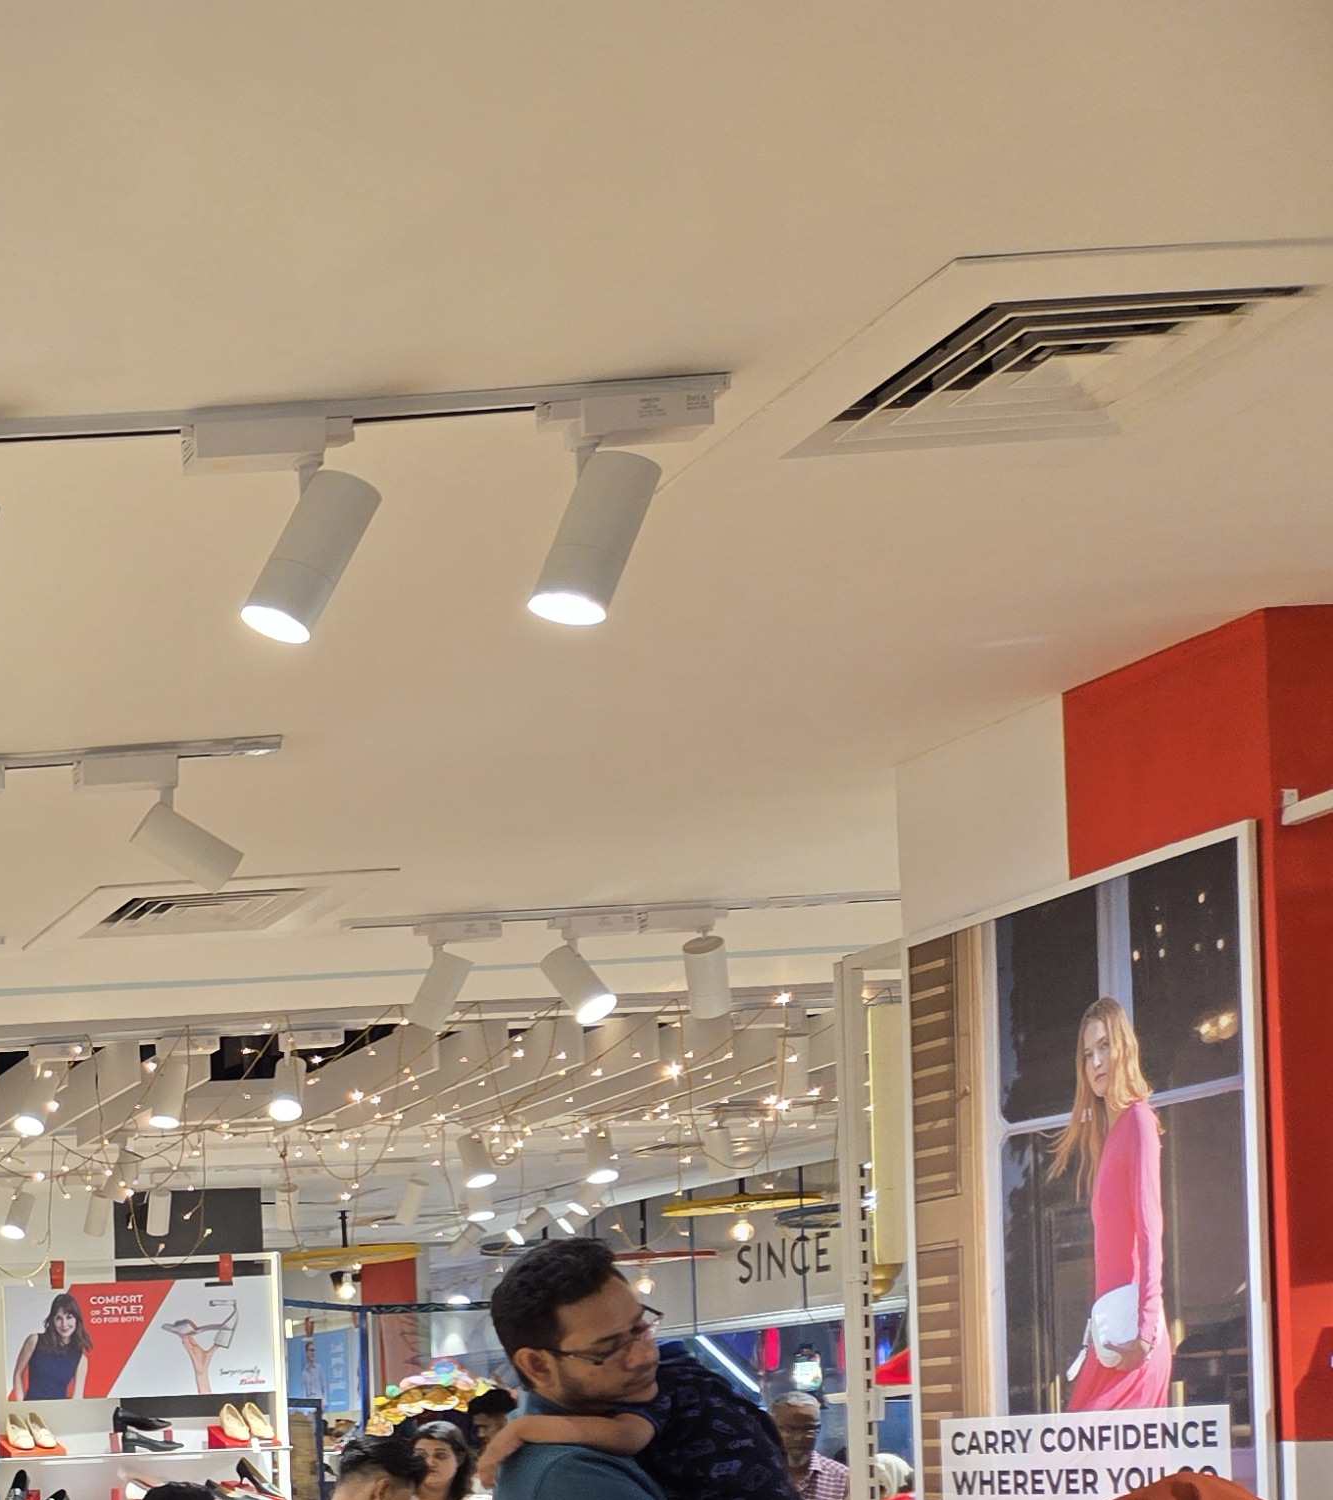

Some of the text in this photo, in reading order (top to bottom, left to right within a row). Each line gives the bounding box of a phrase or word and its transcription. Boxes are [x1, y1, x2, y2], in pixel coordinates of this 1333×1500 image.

[737, 1231, 831, 1284] SINCE
[90, 1294, 143, 1305] COMFORT
[103, 1305, 143, 1315] STYLE?
[951, 1420, 1218, 1455] CARRY CONFIDENCE
[952, 1468, 1098, 1495] WHEREVER
[1107, 1466, 1165, 1493] YOU
